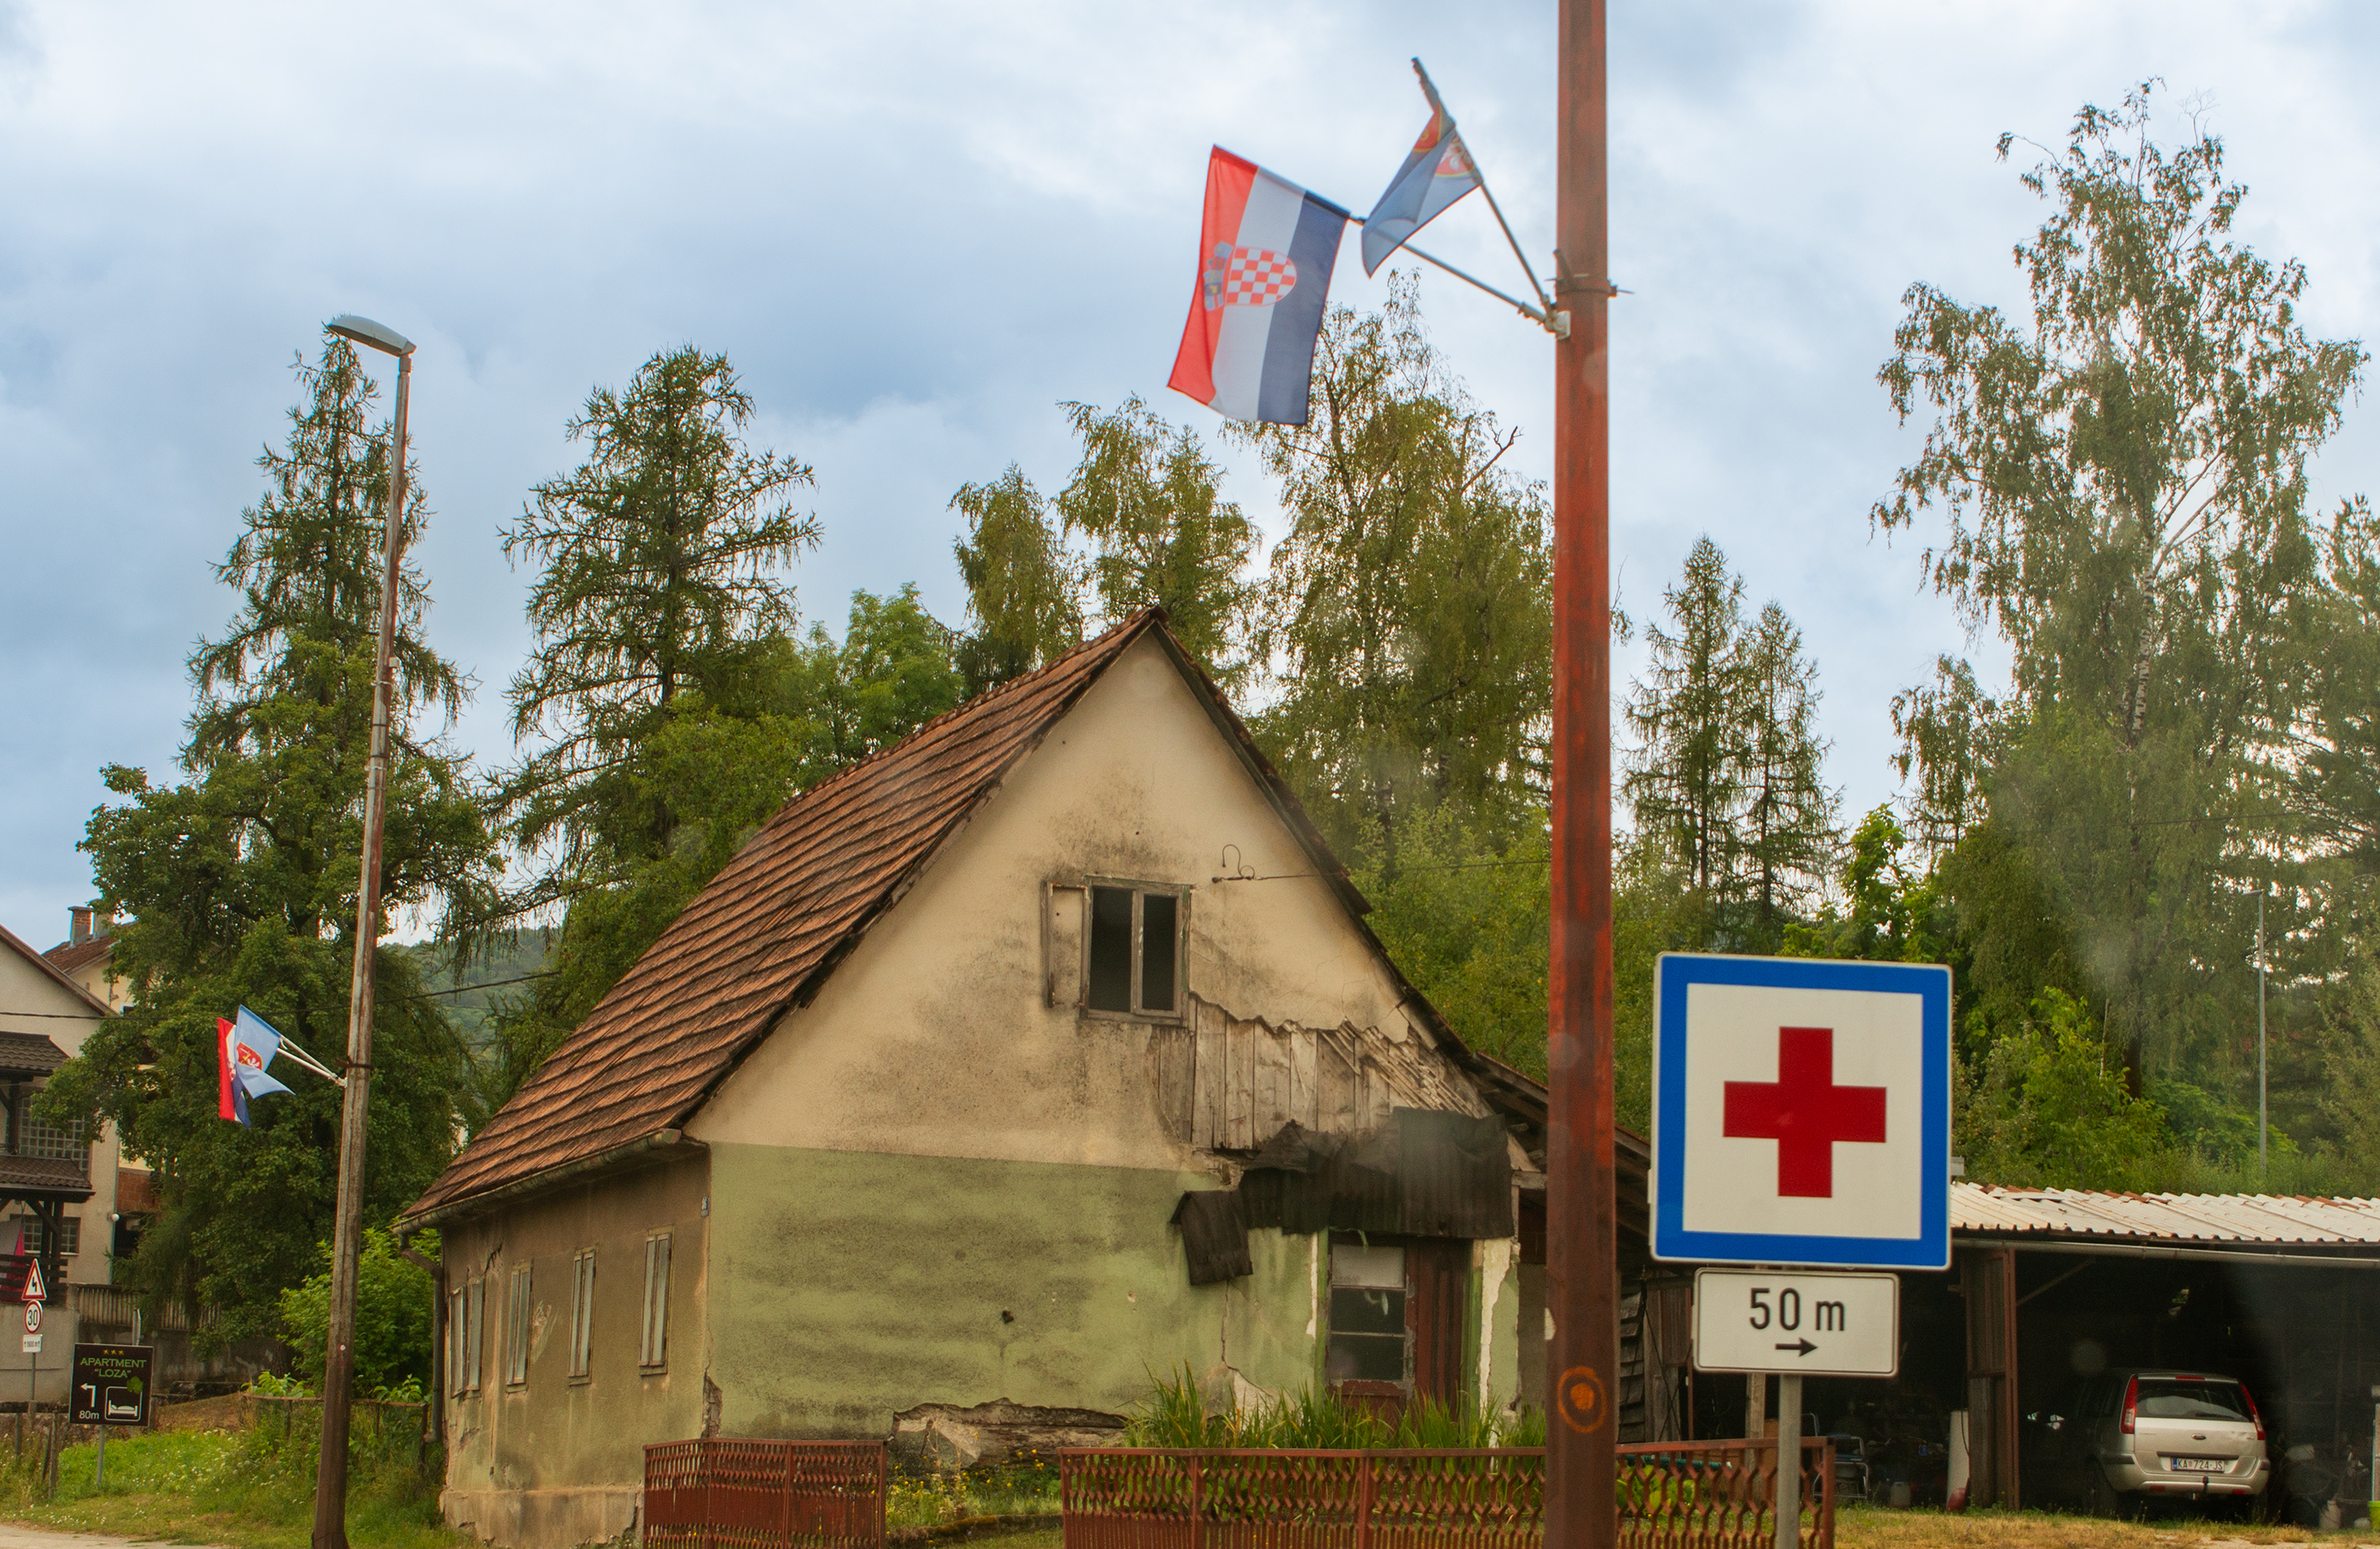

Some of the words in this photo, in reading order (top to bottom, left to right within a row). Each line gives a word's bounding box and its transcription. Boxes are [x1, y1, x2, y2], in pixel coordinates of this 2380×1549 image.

[1749, 1287, 1800, 1331] 50
[1815, 1301, 1844, 1331] m
[28, 1309, 38, 1326] 30
[80, 1357, 147, 1368] APARTMENT
[79, 1410, 100, 1420] 80m
